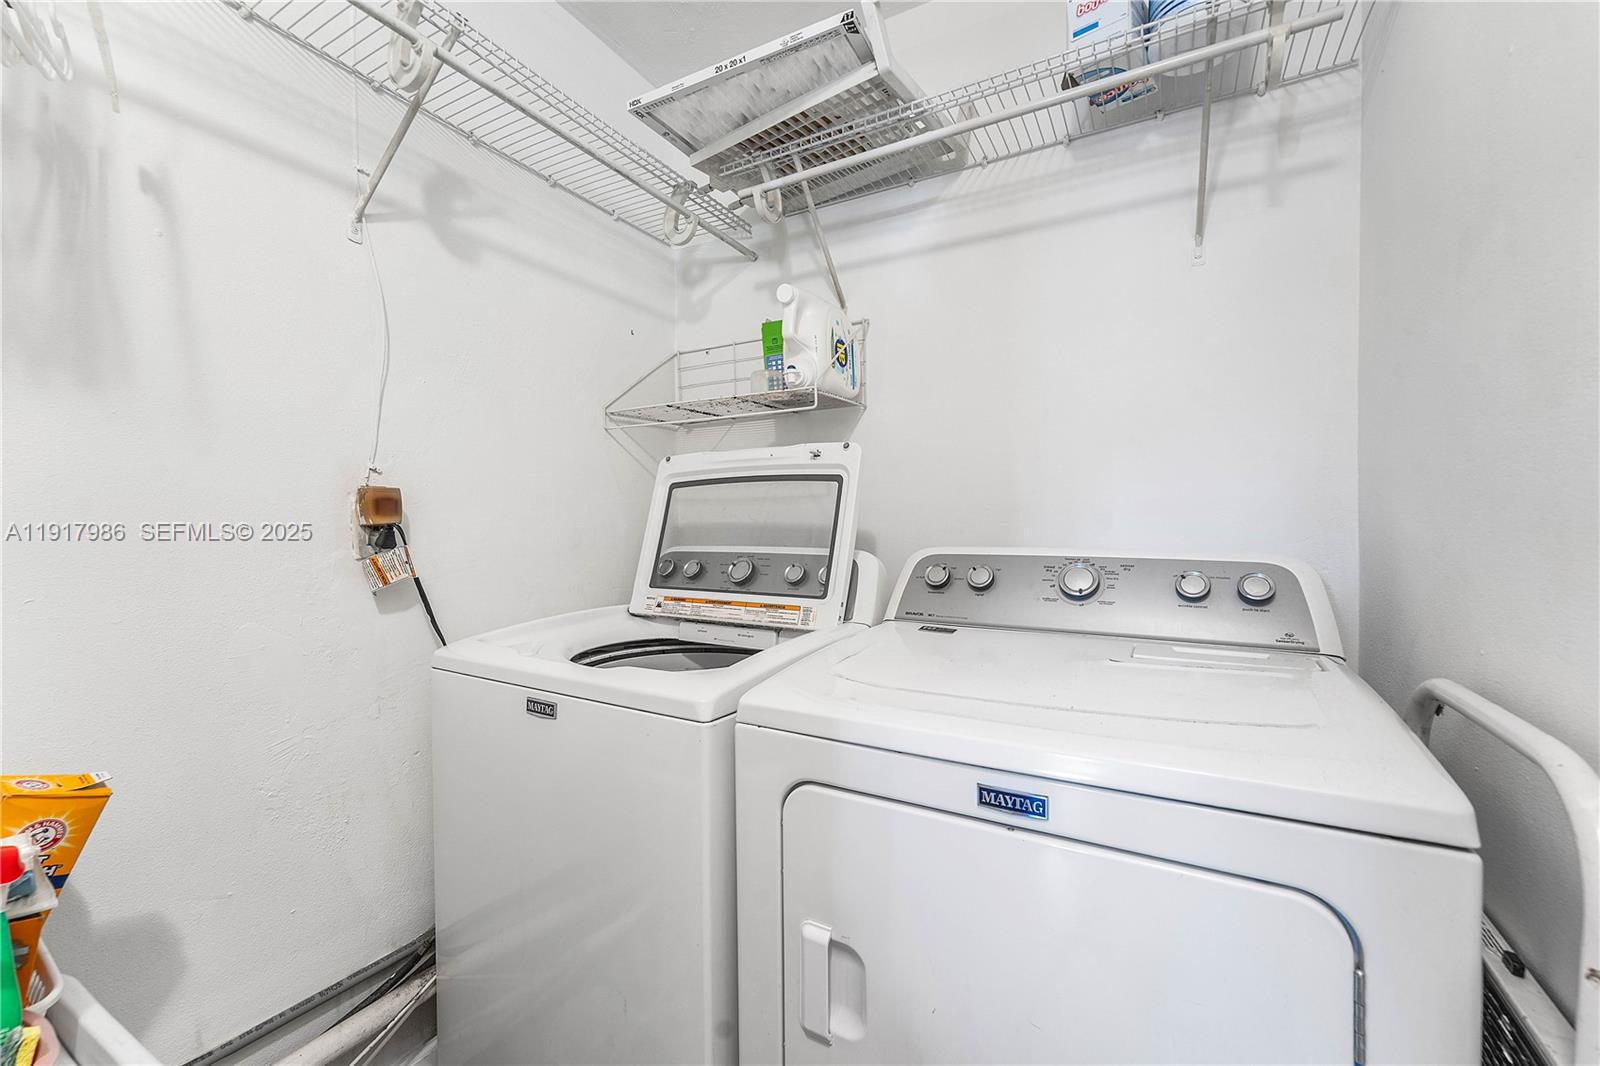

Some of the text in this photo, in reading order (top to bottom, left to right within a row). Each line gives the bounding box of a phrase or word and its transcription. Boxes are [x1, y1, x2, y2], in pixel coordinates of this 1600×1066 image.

[714, 64, 724, 74] 20
[729, 58, 738, 68] 20
[527, 701, 555, 716] MAYTAG
[981, 790, 1044, 815] MAYTAG
